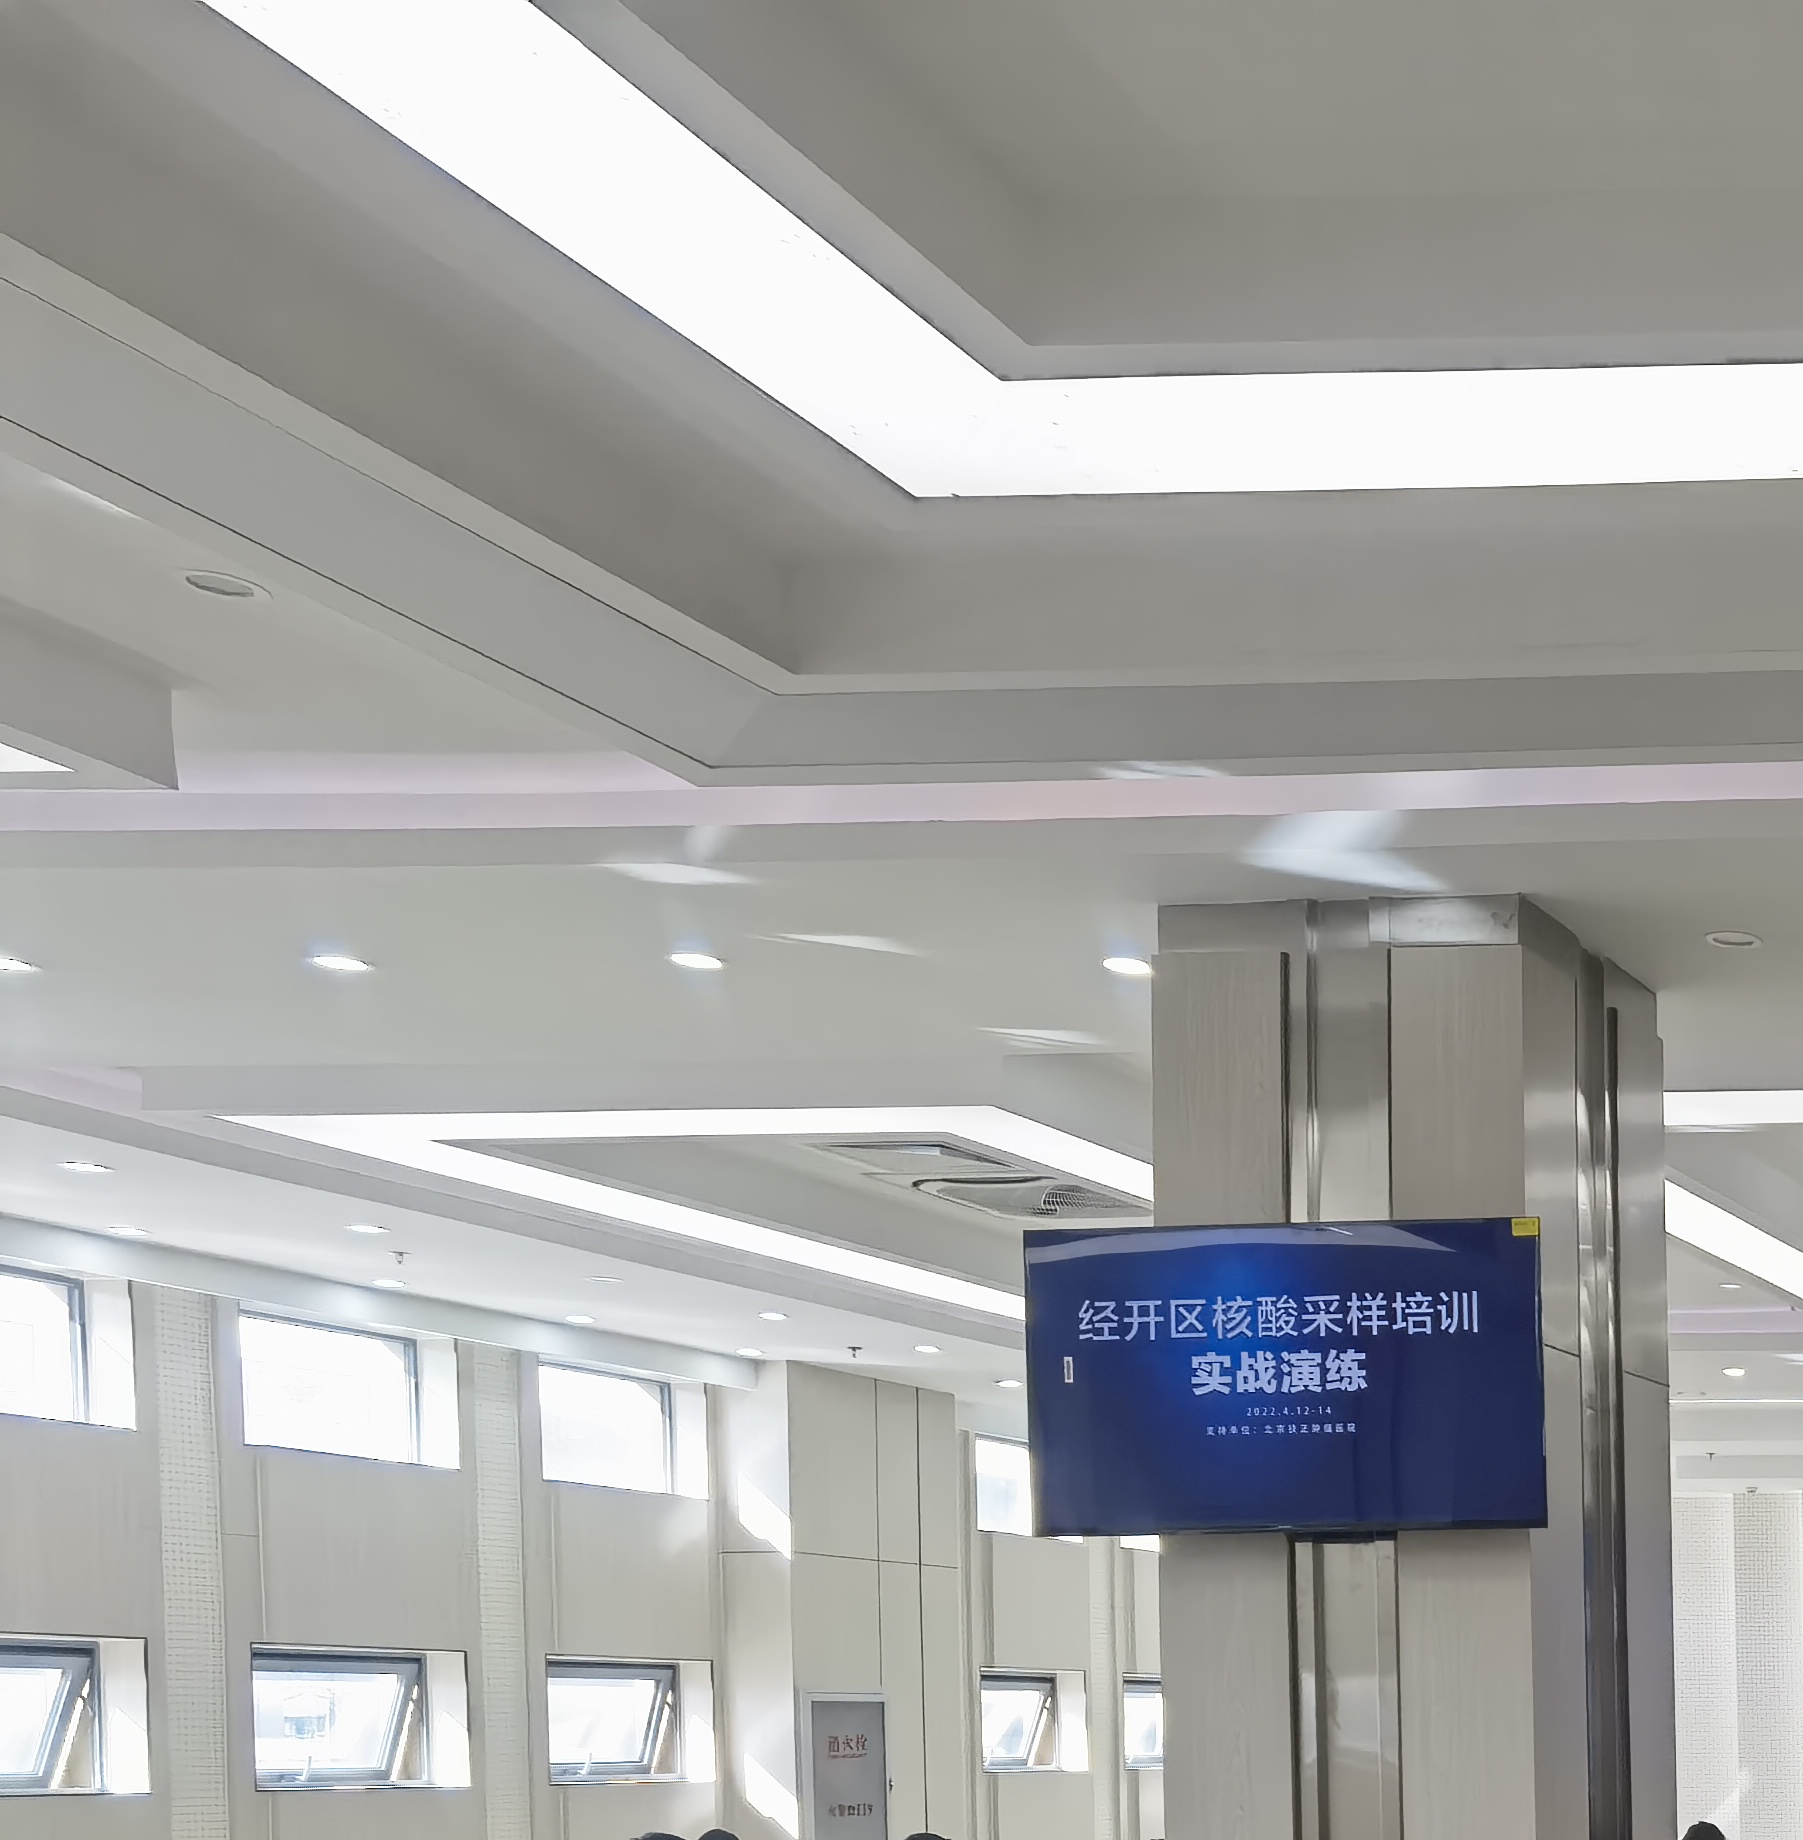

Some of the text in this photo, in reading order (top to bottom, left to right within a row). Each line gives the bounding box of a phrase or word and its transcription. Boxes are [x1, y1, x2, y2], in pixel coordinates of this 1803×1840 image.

[1078, 1290, 1480, 1343] 经开区核酸采样培训
[1191, 1348, 1368, 1396] 实战演练
[1247, 1406, 1332, 1417] 2022.4.12-14
